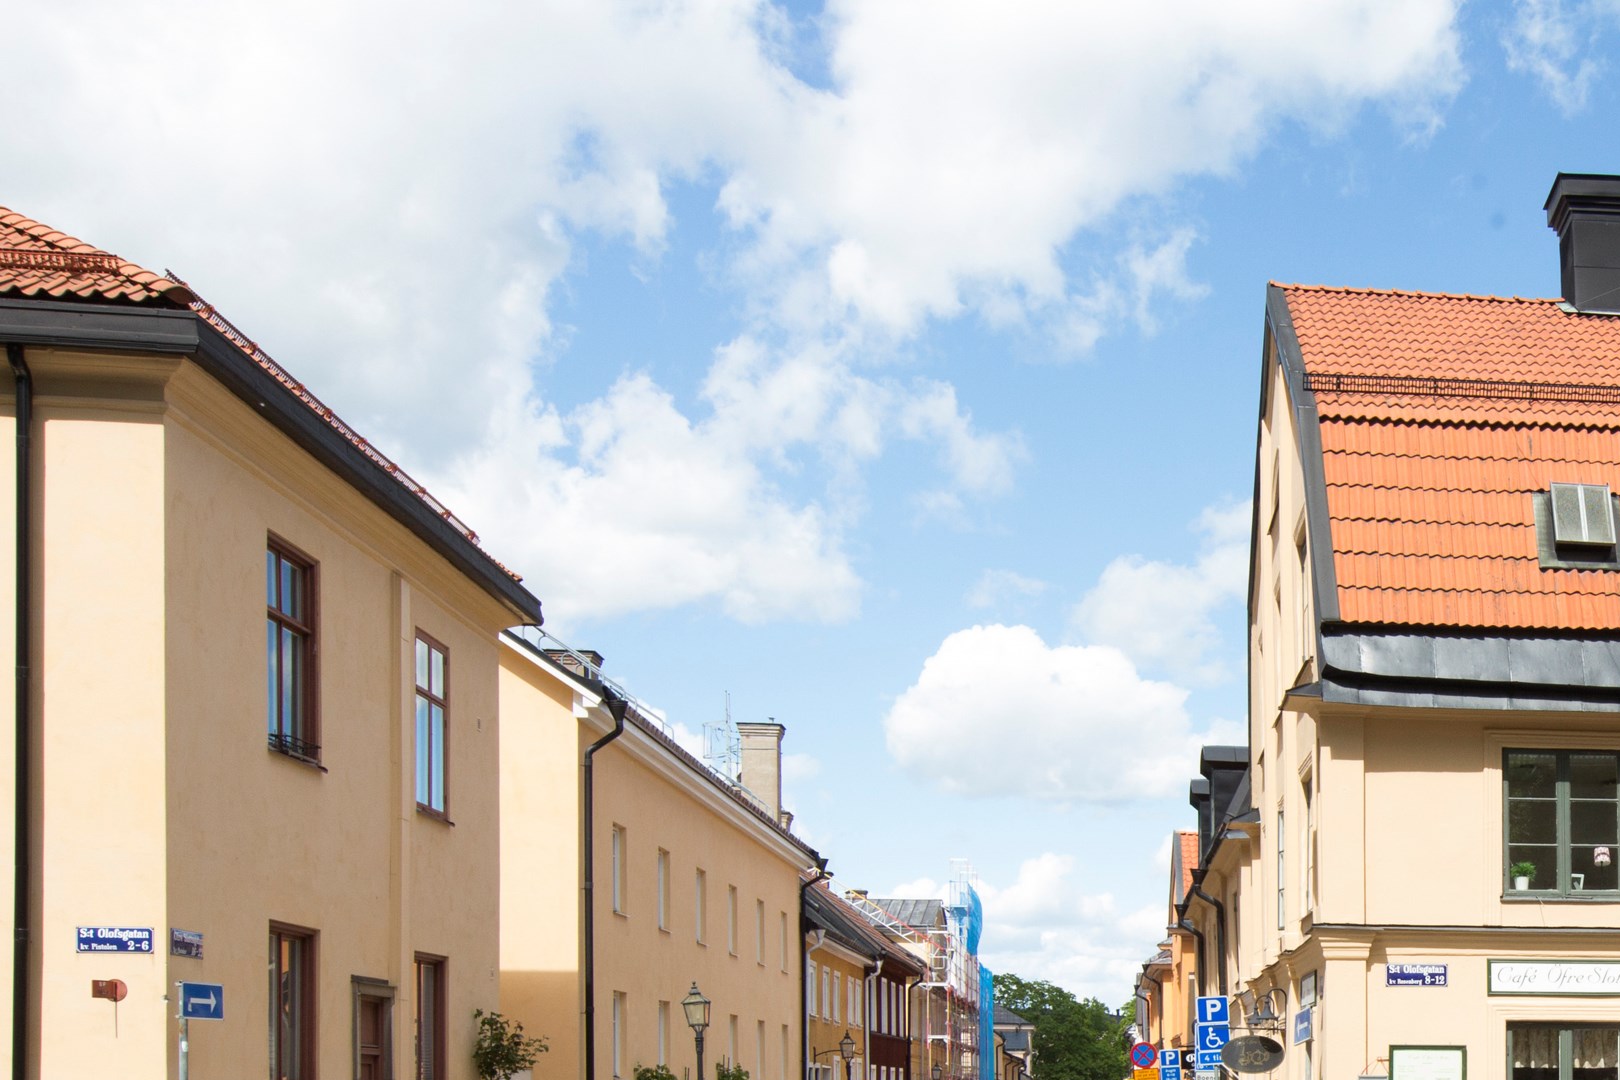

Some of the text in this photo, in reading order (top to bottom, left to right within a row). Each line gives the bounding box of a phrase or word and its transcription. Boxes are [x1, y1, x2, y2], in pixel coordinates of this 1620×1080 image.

[79, 928, 149, 941] S:t Olofsgatan
[127, 941, 149, 950] 2-6
[1389, 965, 1445, 976] S:t Olofsgatan
[1497, 966, 1538, 988] Café
[1547, 963, 1585, 988] Öfre
[1424, 975, 1445, 984] 8-12
[1206, 1000, 1221, 1020] P
[1165, 1052, 1175, 1065] P
[1204, 1054, 1210, 1062] 4
